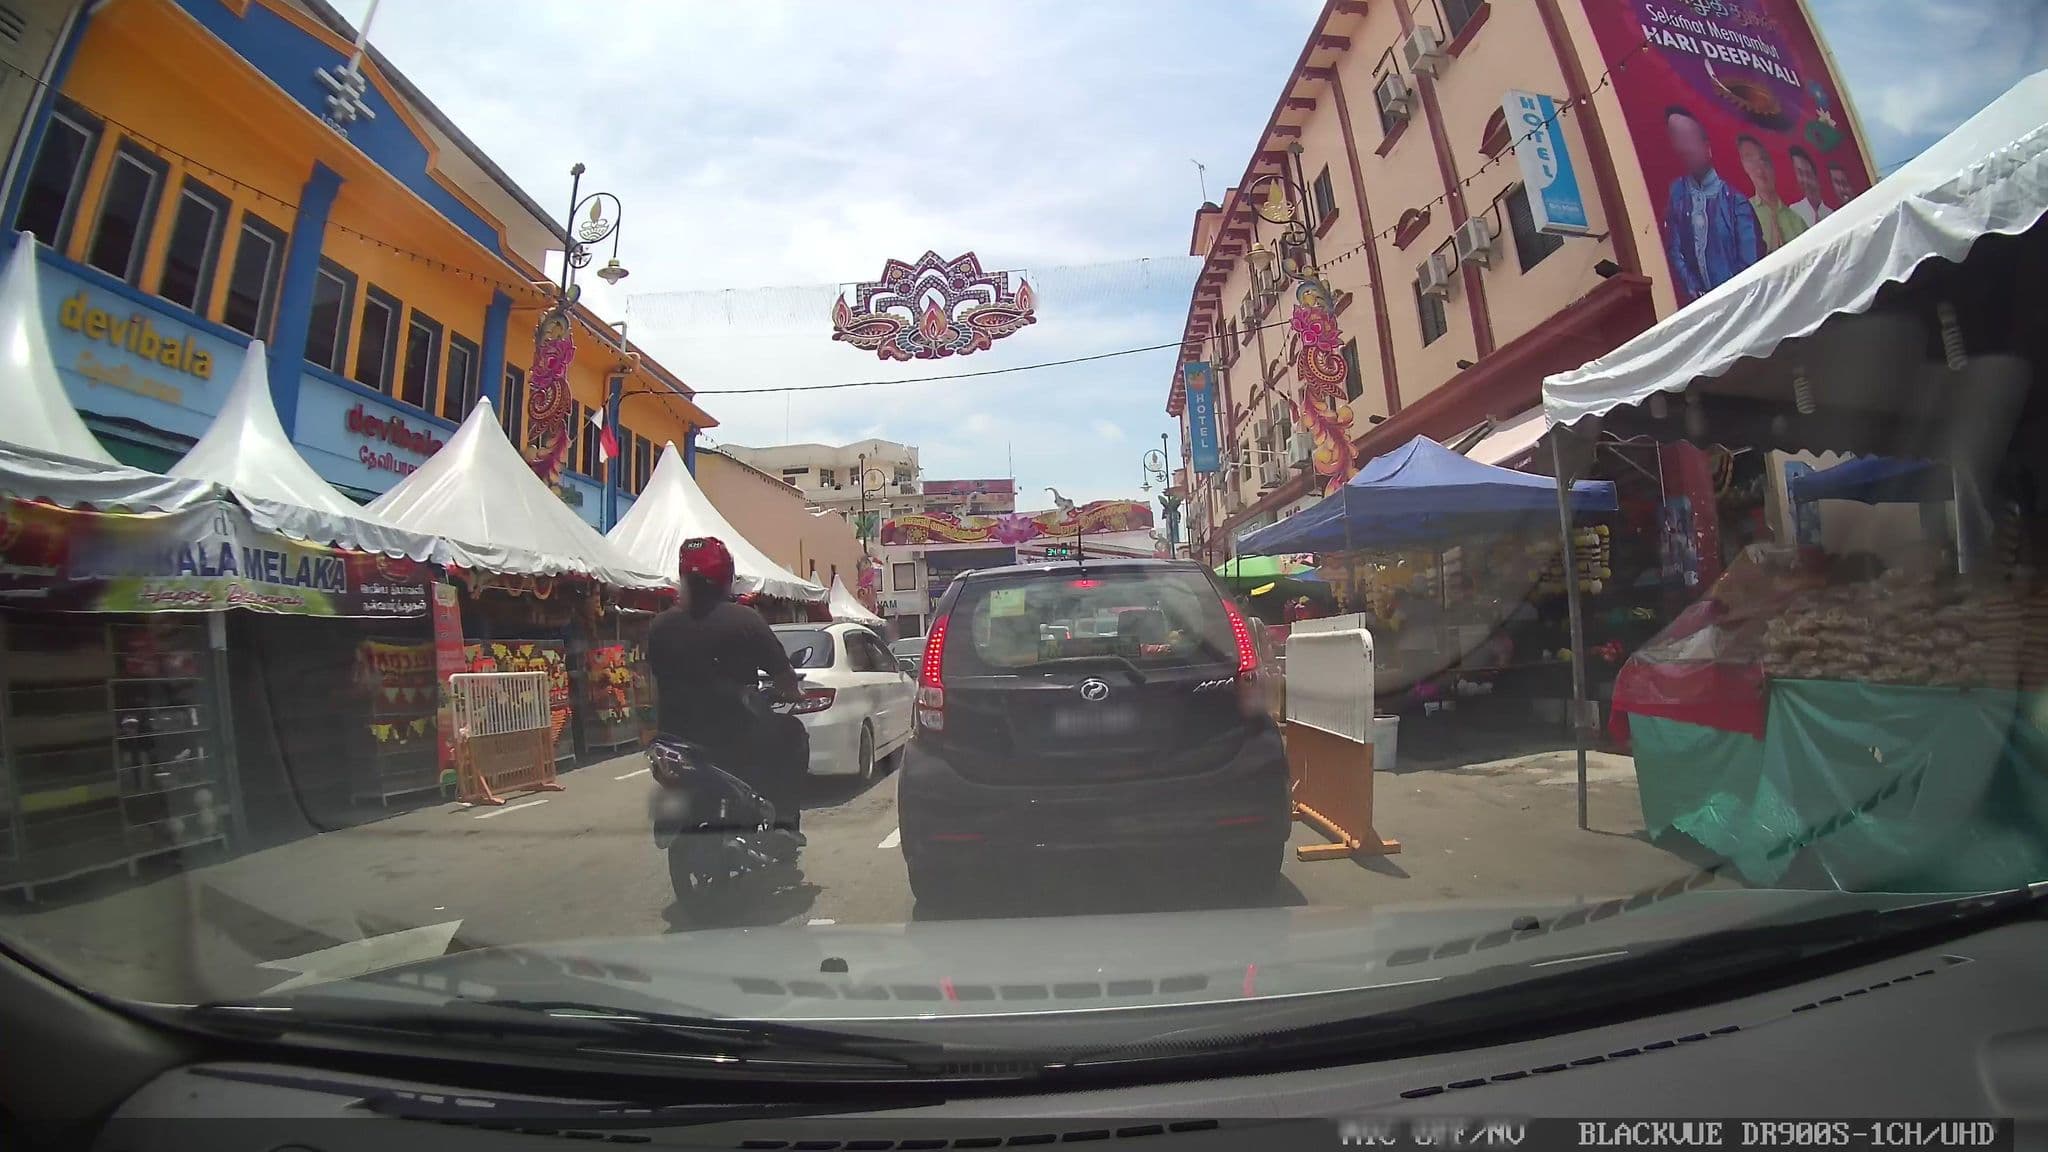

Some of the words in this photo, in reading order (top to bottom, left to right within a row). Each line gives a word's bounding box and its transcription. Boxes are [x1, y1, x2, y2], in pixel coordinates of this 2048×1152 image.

[1641, 24, 1700, 54] HARI
[1701, 40, 1801, 88] DEEPAVALI
[1646, 4, 1706, 35] Selamat
[1707, 20, 1780, 59] Menyambut
[1520, 96, 1553, 178] HOTEL
[60, 290, 214, 380] devibala
[346, 403, 444, 456] devibala
[1196, 393, 1208, 448] HOTEL
[243, 546, 347, 593] MELAKA
